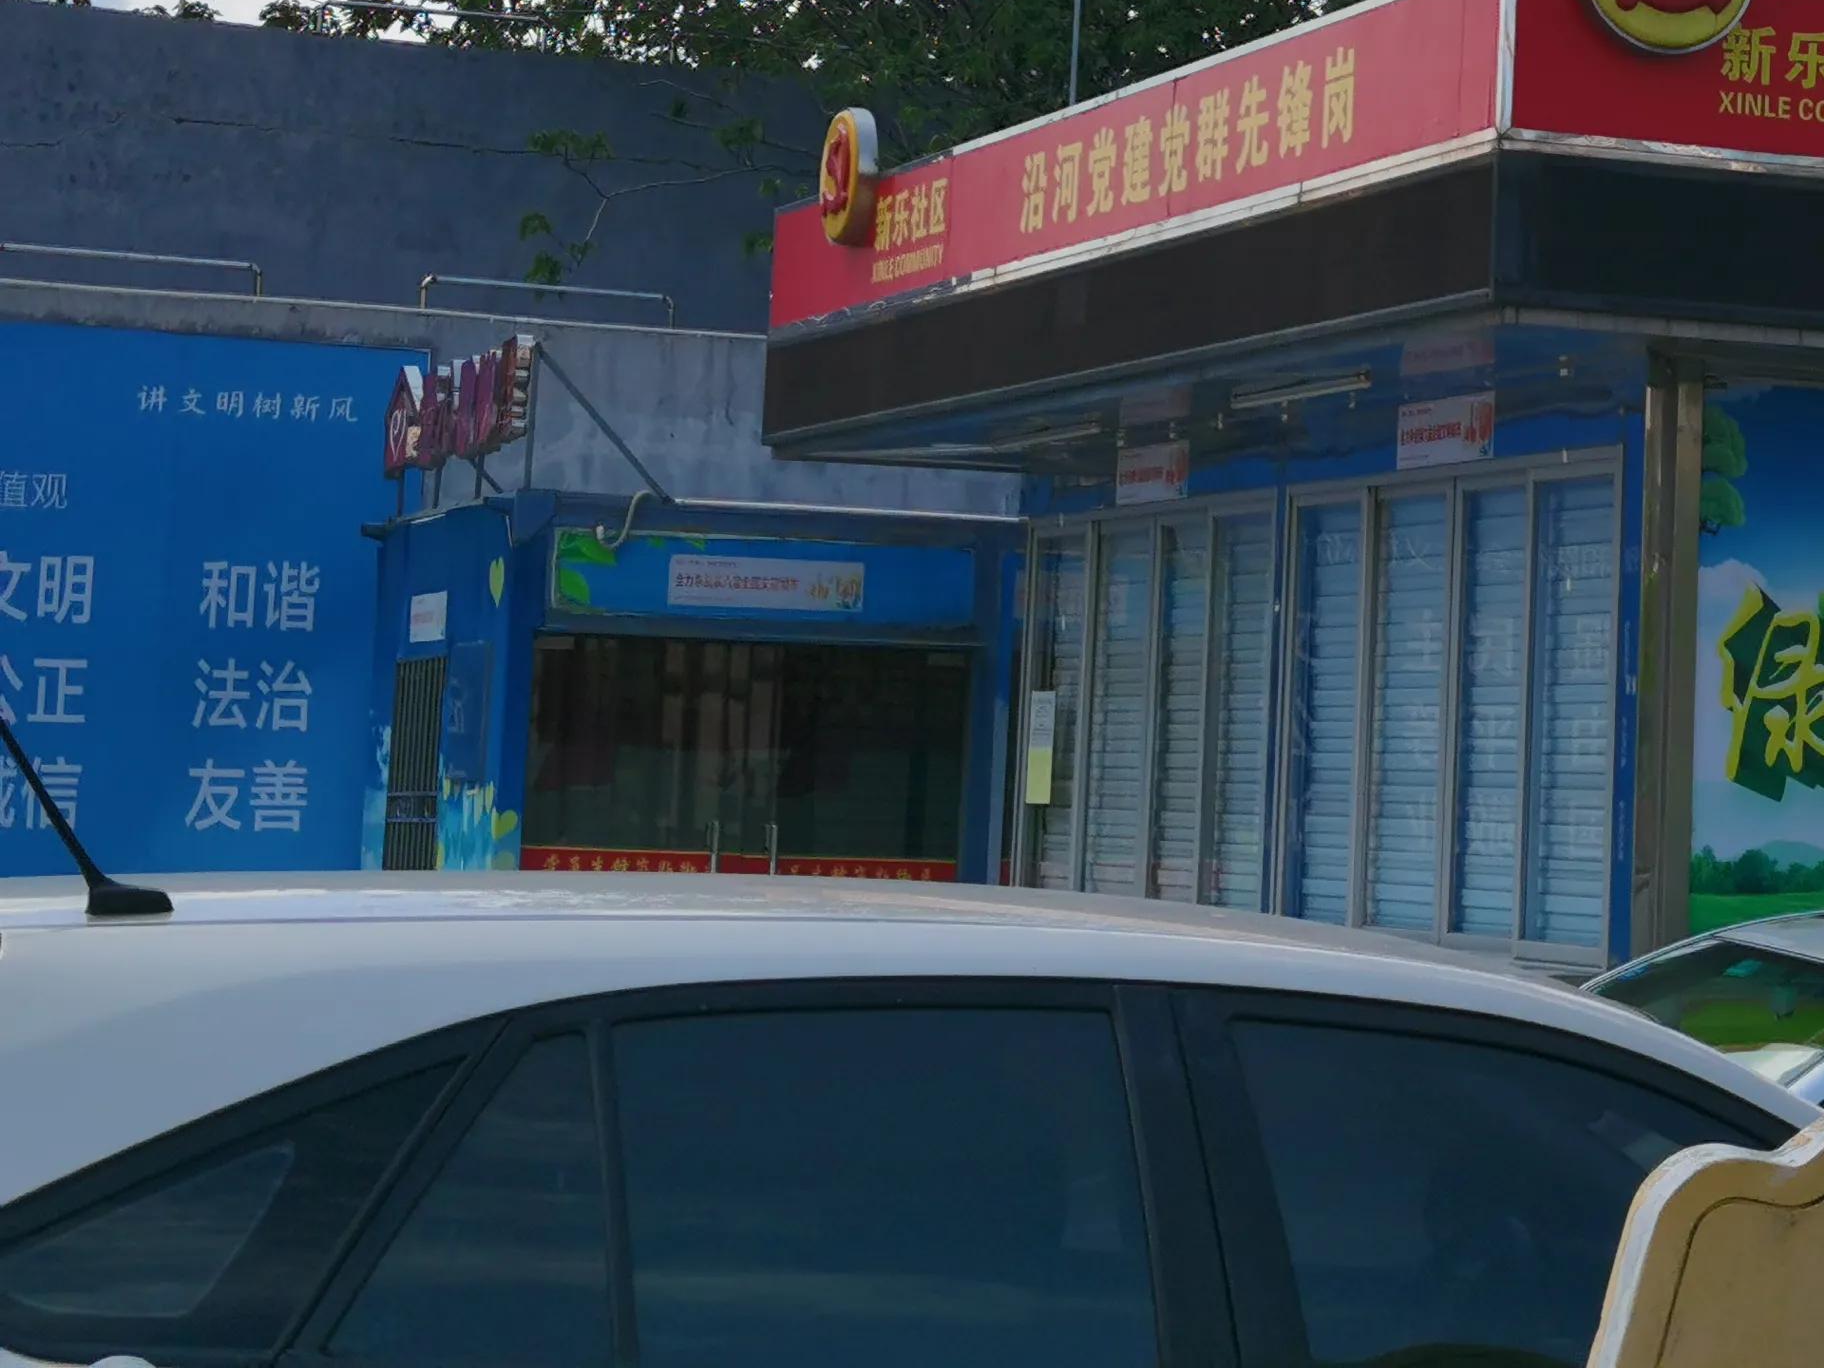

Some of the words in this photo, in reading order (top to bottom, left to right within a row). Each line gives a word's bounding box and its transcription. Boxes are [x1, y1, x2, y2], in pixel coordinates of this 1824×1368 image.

[1019, 46, 1356, 234] 沿河党建党群先锋岗
[1719, 91, 1791, 119] XINLE
[875, 177, 948, 252] 新乐社区
[137, 385, 358, 423] 讲文明树新风
[200, 560, 322, 632] 和谐
[191, 658, 313, 732] 法治
[0, 754, 83, 832] 信
[184, 758, 309, 832] 友善
